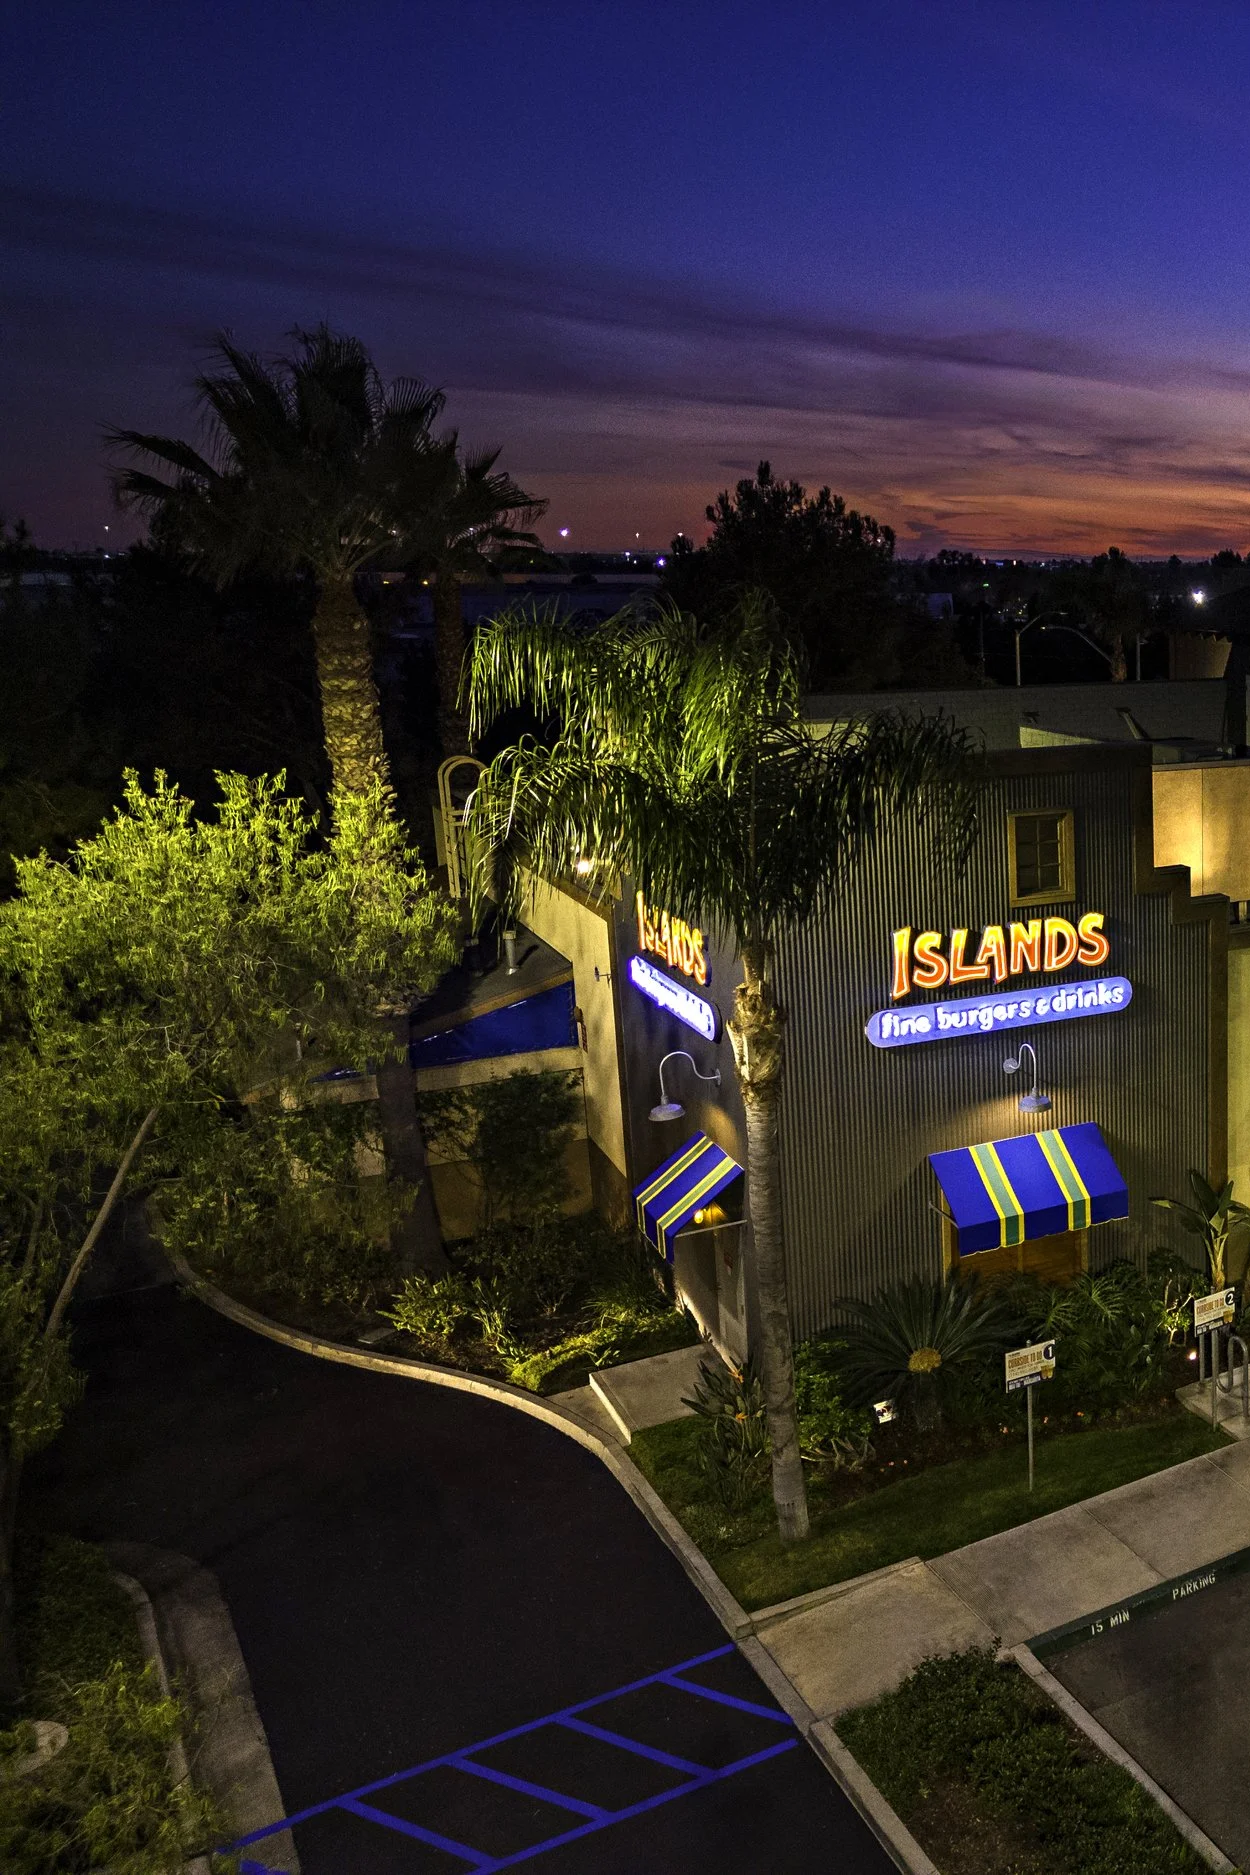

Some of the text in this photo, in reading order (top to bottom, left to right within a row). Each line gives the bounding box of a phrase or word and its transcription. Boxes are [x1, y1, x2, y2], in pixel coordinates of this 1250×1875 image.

[891, 911, 1111, 1000] ISLANDS
[880, 982, 1124, 1039] fine burgers & drinks
[1172, 1572, 1216, 1600] PARKING
[1091, 1609, 1130, 1636] 15 MIN
